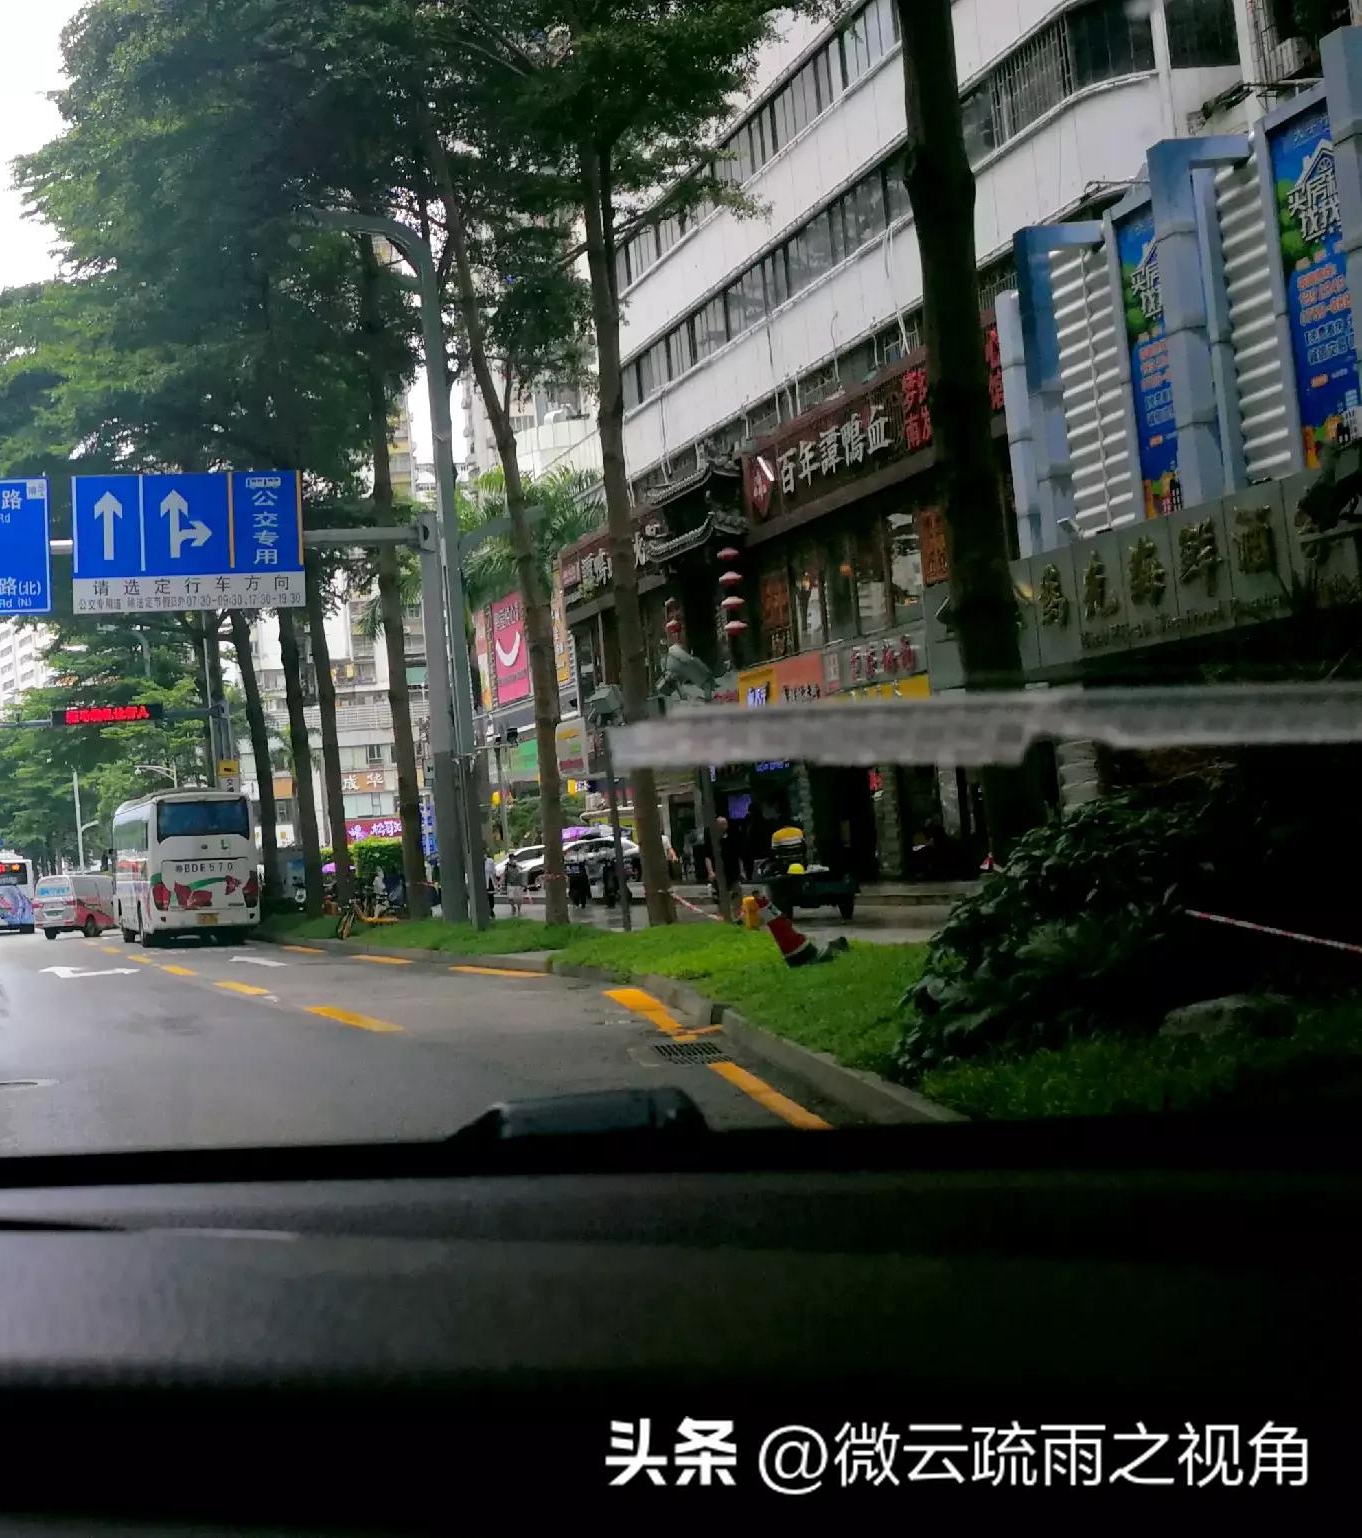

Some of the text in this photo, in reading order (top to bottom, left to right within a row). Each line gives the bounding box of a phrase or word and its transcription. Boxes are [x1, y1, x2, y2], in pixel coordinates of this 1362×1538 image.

[251, 490, 279, 565] 公交专用
[93, 575, 290, 597] 请选定行车方向
